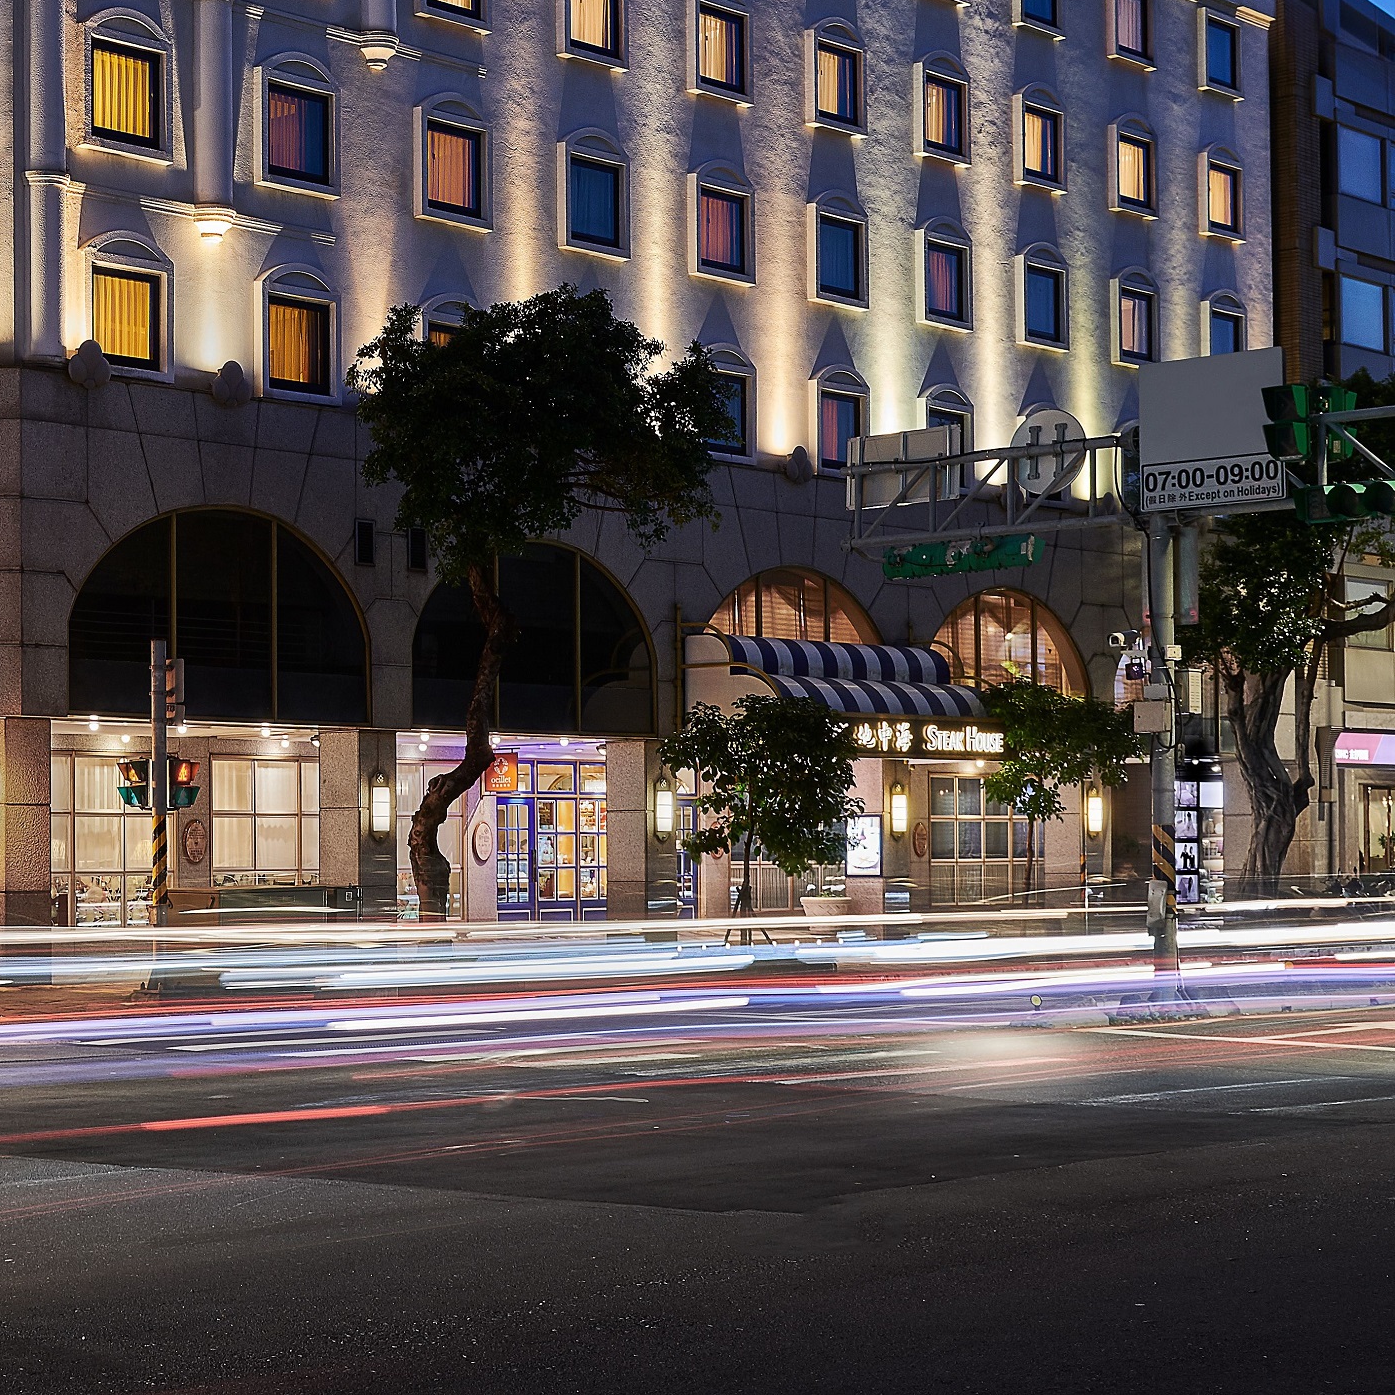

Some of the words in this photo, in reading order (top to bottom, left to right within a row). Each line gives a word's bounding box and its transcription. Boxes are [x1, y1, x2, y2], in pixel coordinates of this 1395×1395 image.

[1145, 459, 1279, 493] 07:00-09:00
[1223, 489, 1235, 498] on
[1237, 482, 1281, 498] Holidays)
[855, 721, 913, 752] 地中海
